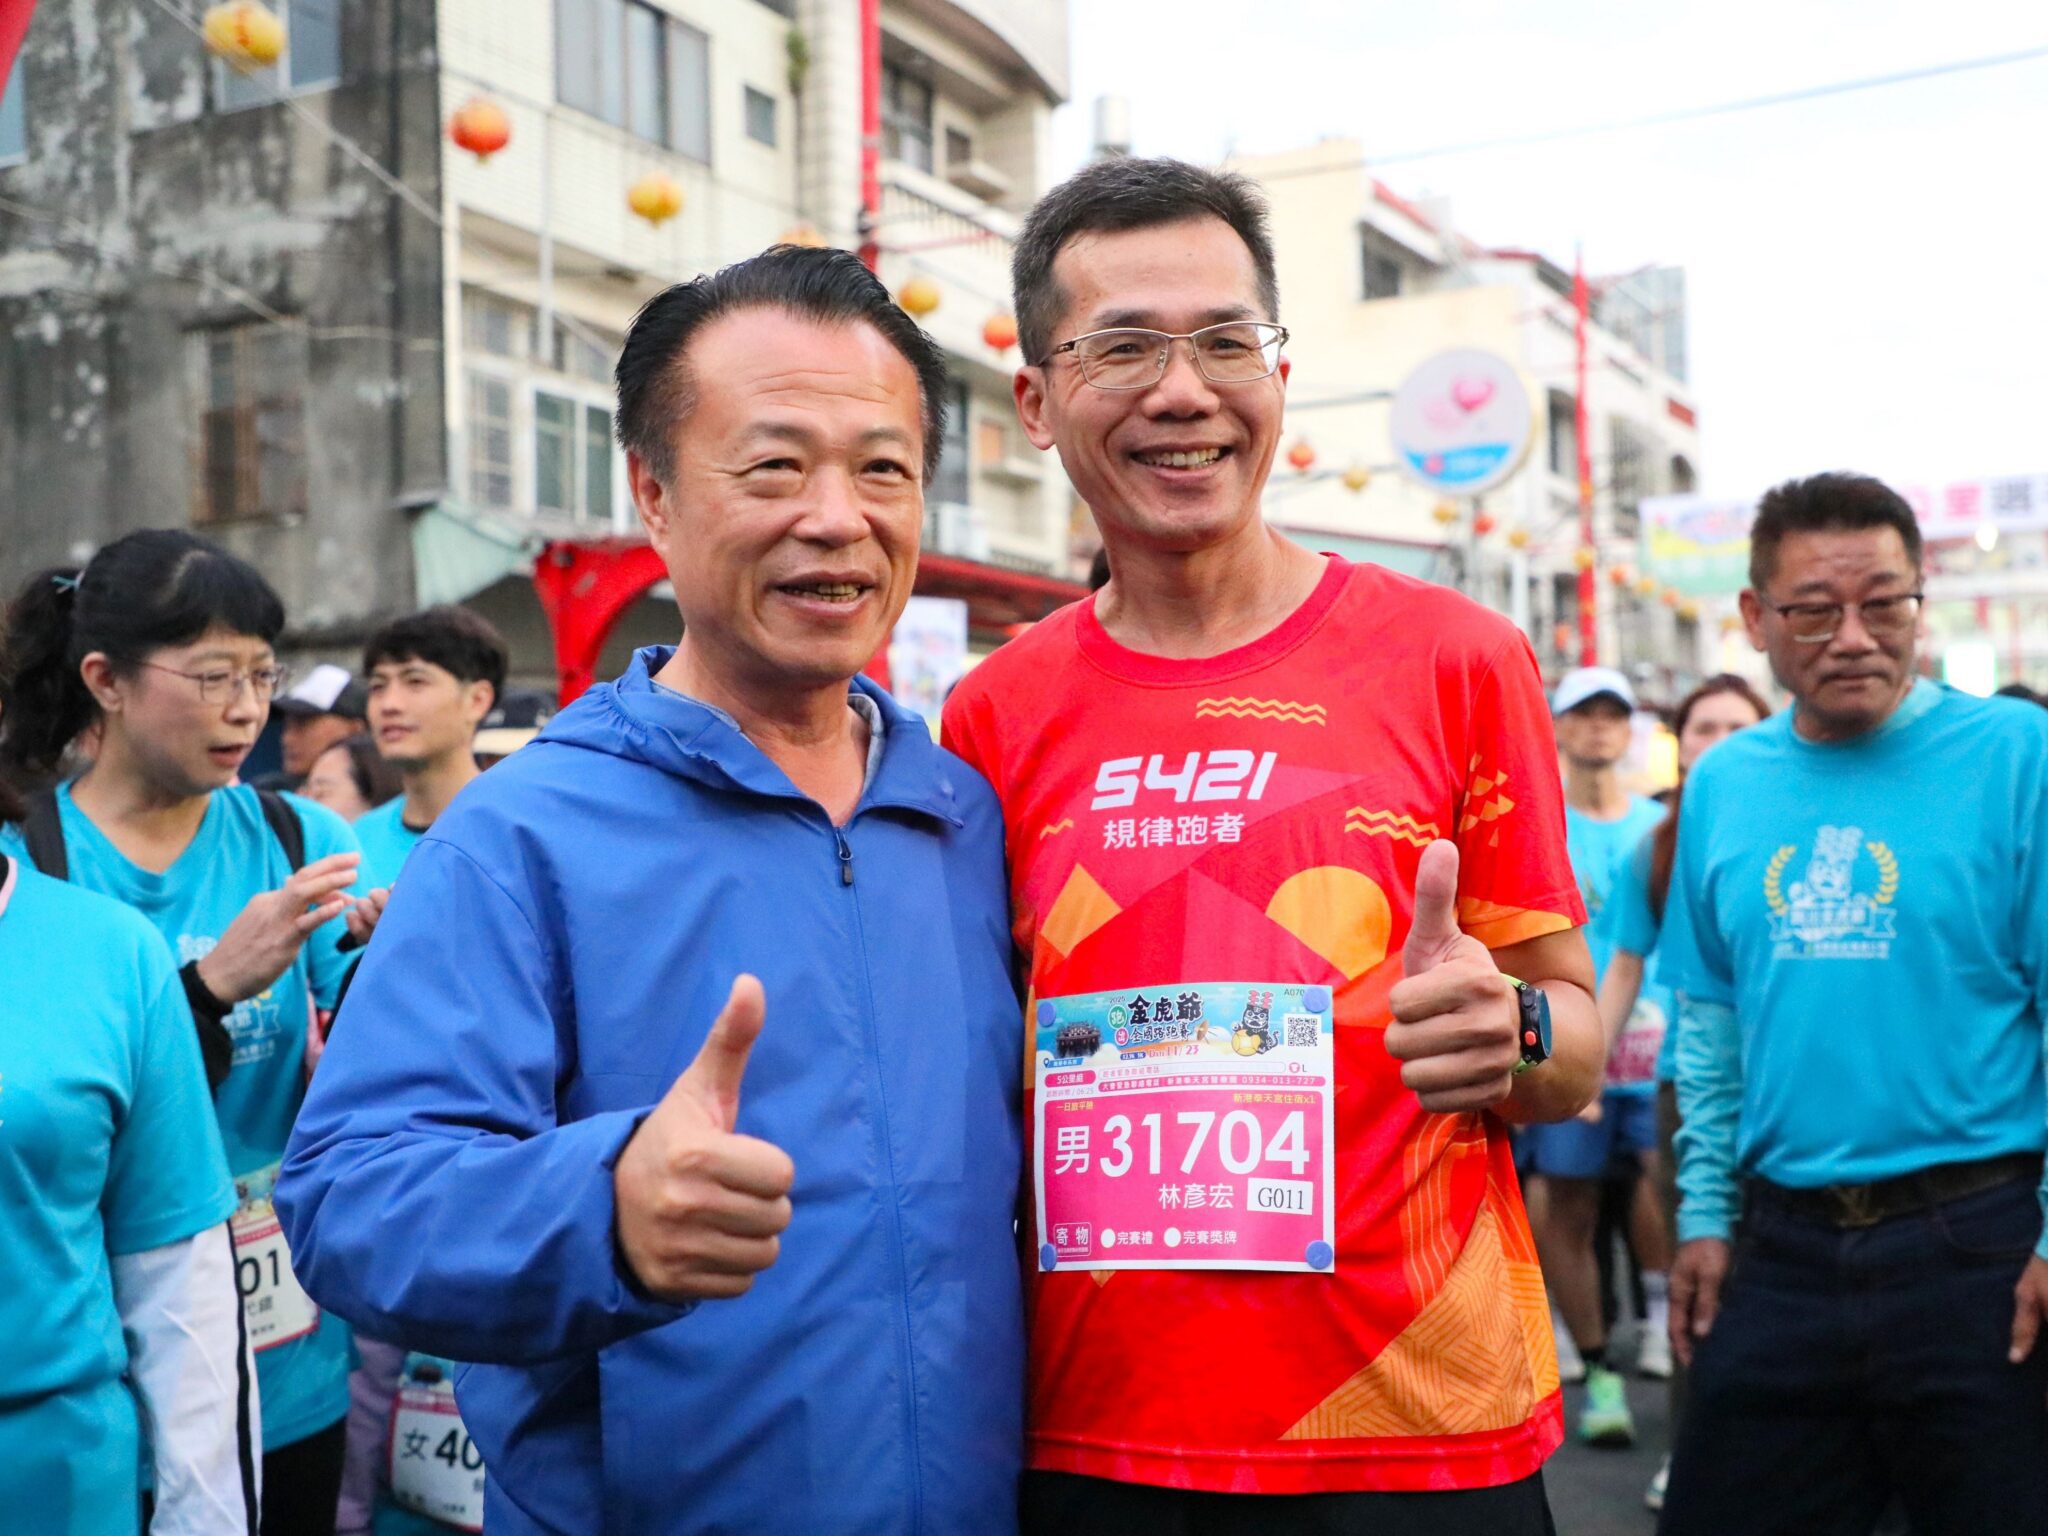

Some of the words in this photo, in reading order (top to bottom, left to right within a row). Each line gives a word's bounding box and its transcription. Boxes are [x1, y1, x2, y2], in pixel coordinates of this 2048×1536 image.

[1103, 812, 1246, 849] 規律跑者
[1128, 992, 1202, 1025] 金虎爺
[1131, 1022, 1190, 1043] 全國路跑賽
[1056, 1073, 1085, 1085] 5公里組
[1302, 1064, 1307, 1072] L
[1054, 1125, 1090, 1174] 男
[1100, 1110, 1310, 1178] 31704
[1159, 1183, 1235, 1210] 林彥宏
[1257, 1187, 1304, 1210] G011
[1056, 1226, 1089, 1246] 寄物
[1117, 1229, 1153, 1246] 完賽禮
[1183, 1229, 1237, 1246] 完賽獎牌
[402, 1428, 429, 1461] 女
